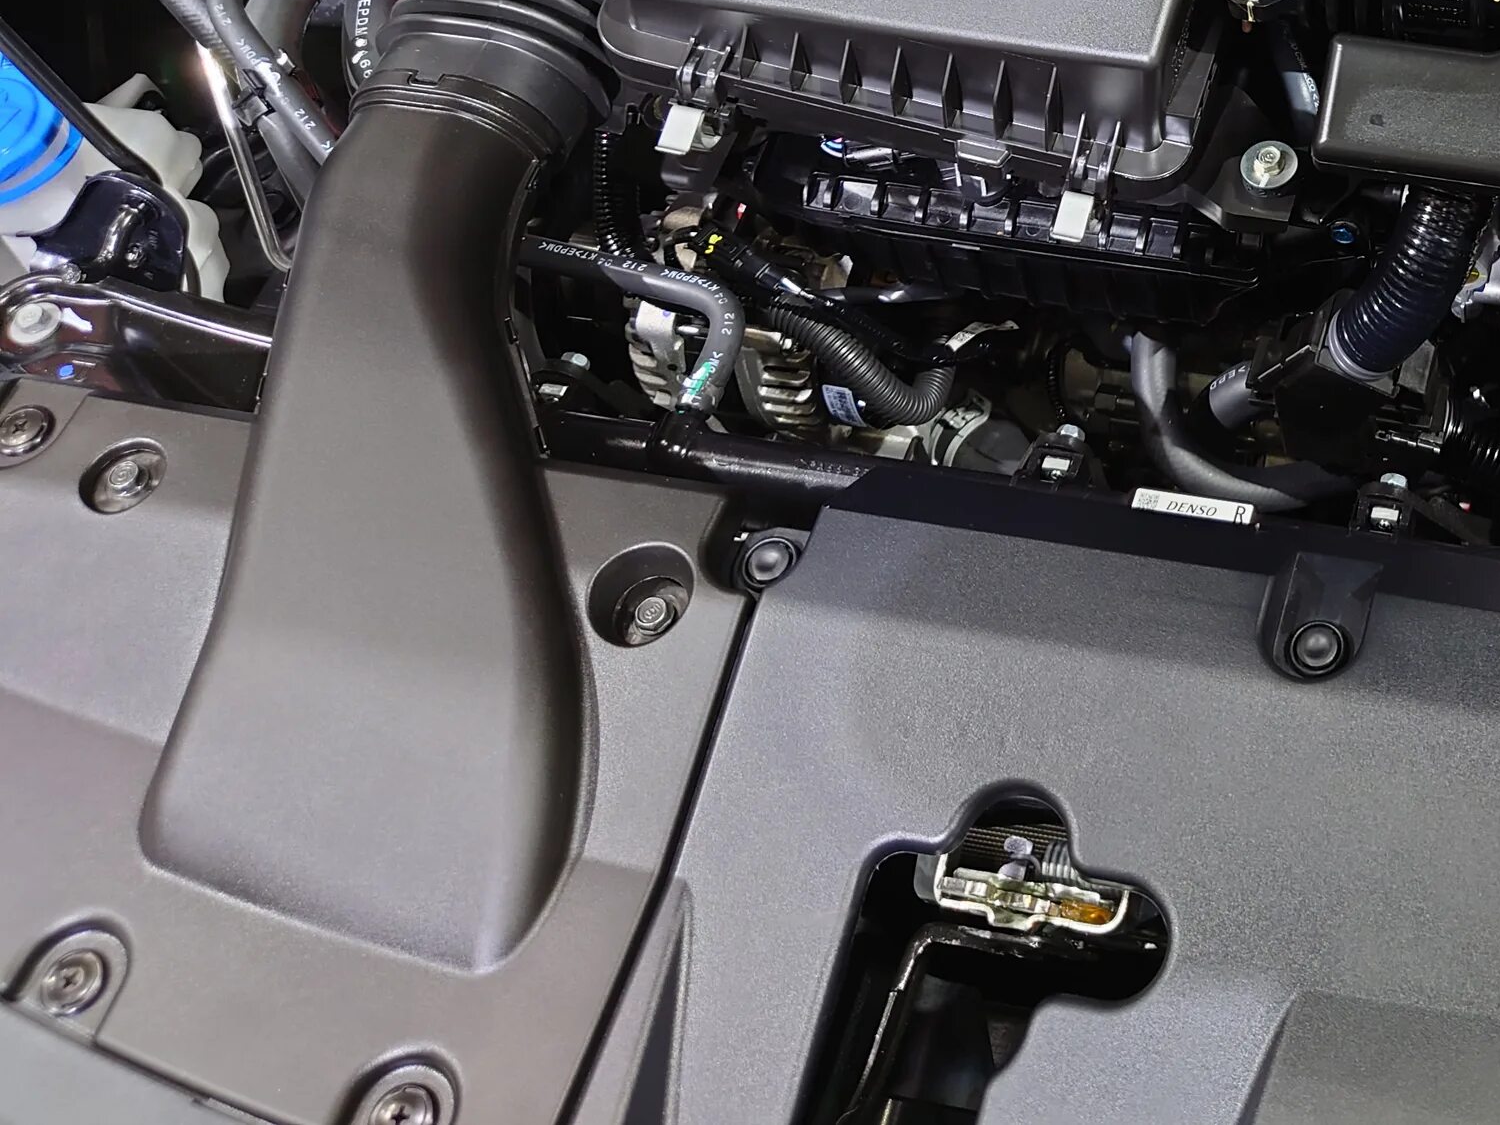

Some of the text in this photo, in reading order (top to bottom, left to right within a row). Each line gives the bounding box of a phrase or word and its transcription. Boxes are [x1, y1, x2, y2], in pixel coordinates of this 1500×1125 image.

[213, 3, 232, 26] 212
[294, 108, 317, 131] 212
[621, 259, 648, 273] 212
[721, 311, 736, 336] 212
[1166, 500, 1246, 524] DENSO R
